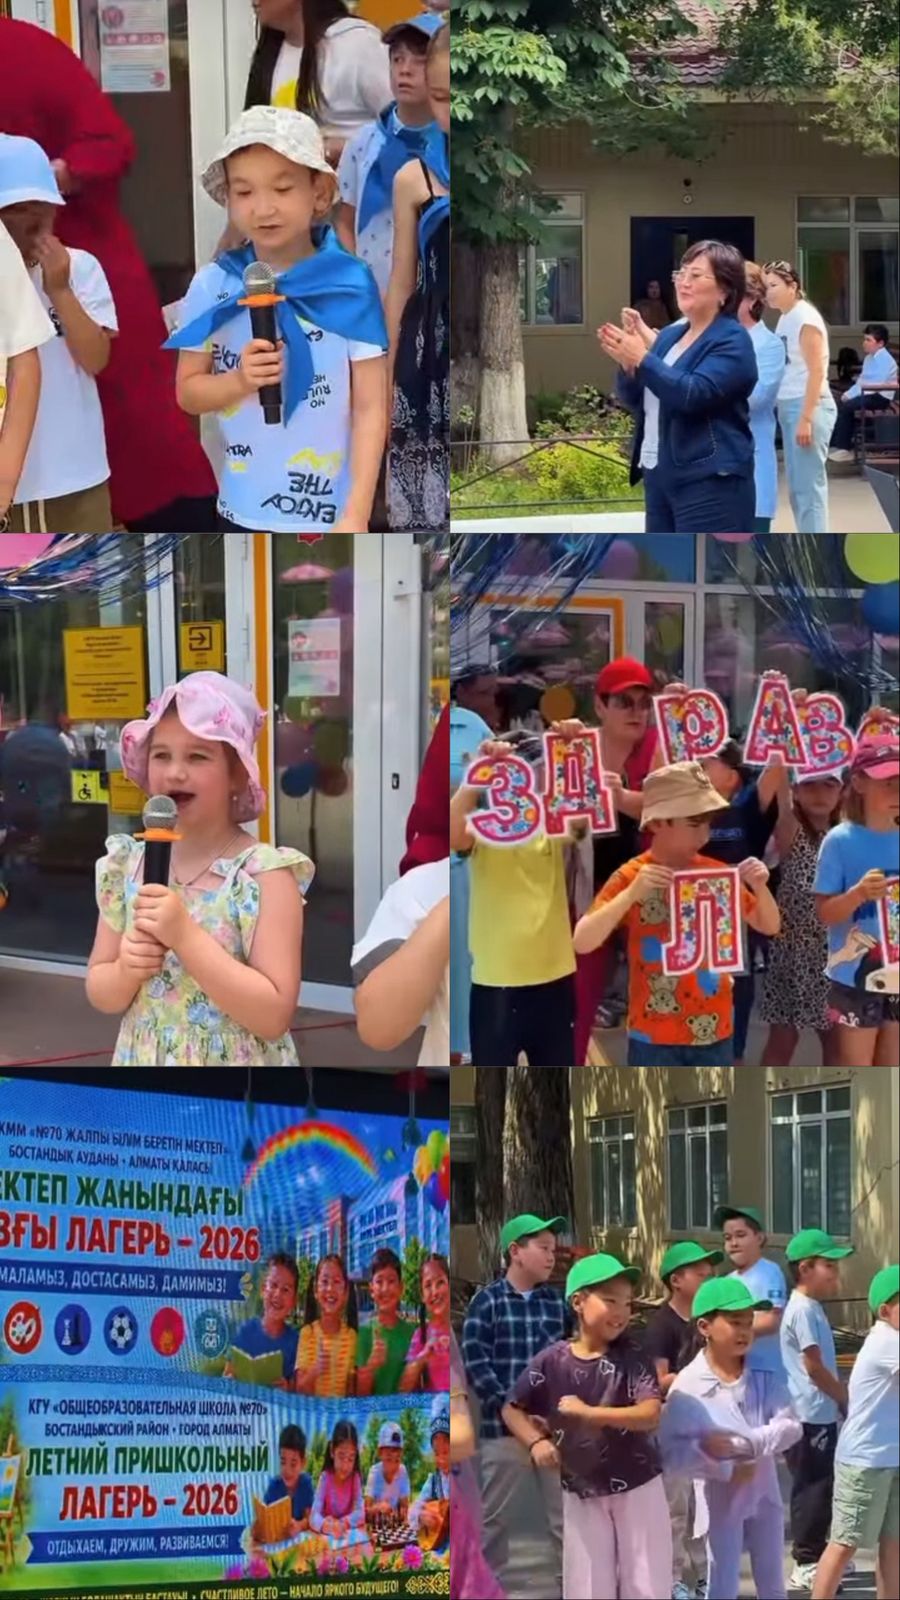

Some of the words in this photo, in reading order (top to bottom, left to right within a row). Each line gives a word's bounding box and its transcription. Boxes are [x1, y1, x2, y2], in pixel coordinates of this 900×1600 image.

[288, 471, 333, 496] THE
[260, 493, 336, 524] ENJOY
[65, 1127, 110, 1145] ЖАЛПЫ
[77, 1150, 119, 1166] АУДАНЫ
[129, 1155, 170, 1170] АЛМАТЫ
[76, 1175, 244, 1218] ЖАНЫНДАҒЫ
[66, 1217, 171, 1257] ЛАГЕРЬ
[200, 1224, 261, 1263] 2026
[71, 1270, 159, 1291] ДОСТАСАМЫЗ,
[162, 1275, 227, 1294] ДАМИМЫЗ!
[28, 1399, 50, 1415] КГУ
[53, 1399, 196, 1418] «ОБЩЕОБРАЗОВАТЕЛЬНАЯ
[198, 1400, 237, 1416] ШКОЛА
[45, 1421, 134, 1438] БОСТАНДЫКСКИЙ
[136, 1421, 169, 1436] РАЙОН
[179, 1423, 210, 1437] ГОРОД
[212, 1423, 251, 1436] АЛМАТЫ
[26, 1441, 108, 1476] ЛЕТНИЙ
[114, 1440, 269, 1475] ПРИШКОЛЬНЫЙ
[59, 1484, 158, 1521] ЛАГЕРЬ
[182, 1483, 239, 1516] 2026
[47, 1540, 107, 1557] ОТДЫХАЕМ,
[109, 1538, 157, 1555] ДРУЖИМ,
[160, 1534, 229, 1550] РАЗВИВАЕМСЯ!
[257, 1585, 278, 1600] ЛЕТО
[290, 1584, 323, 1598] НАЧАЛО
[324, 1582, 355, 1597] ЯРКОГО
[356, 1580, 399, 1597] БУДУЩЕГО!
